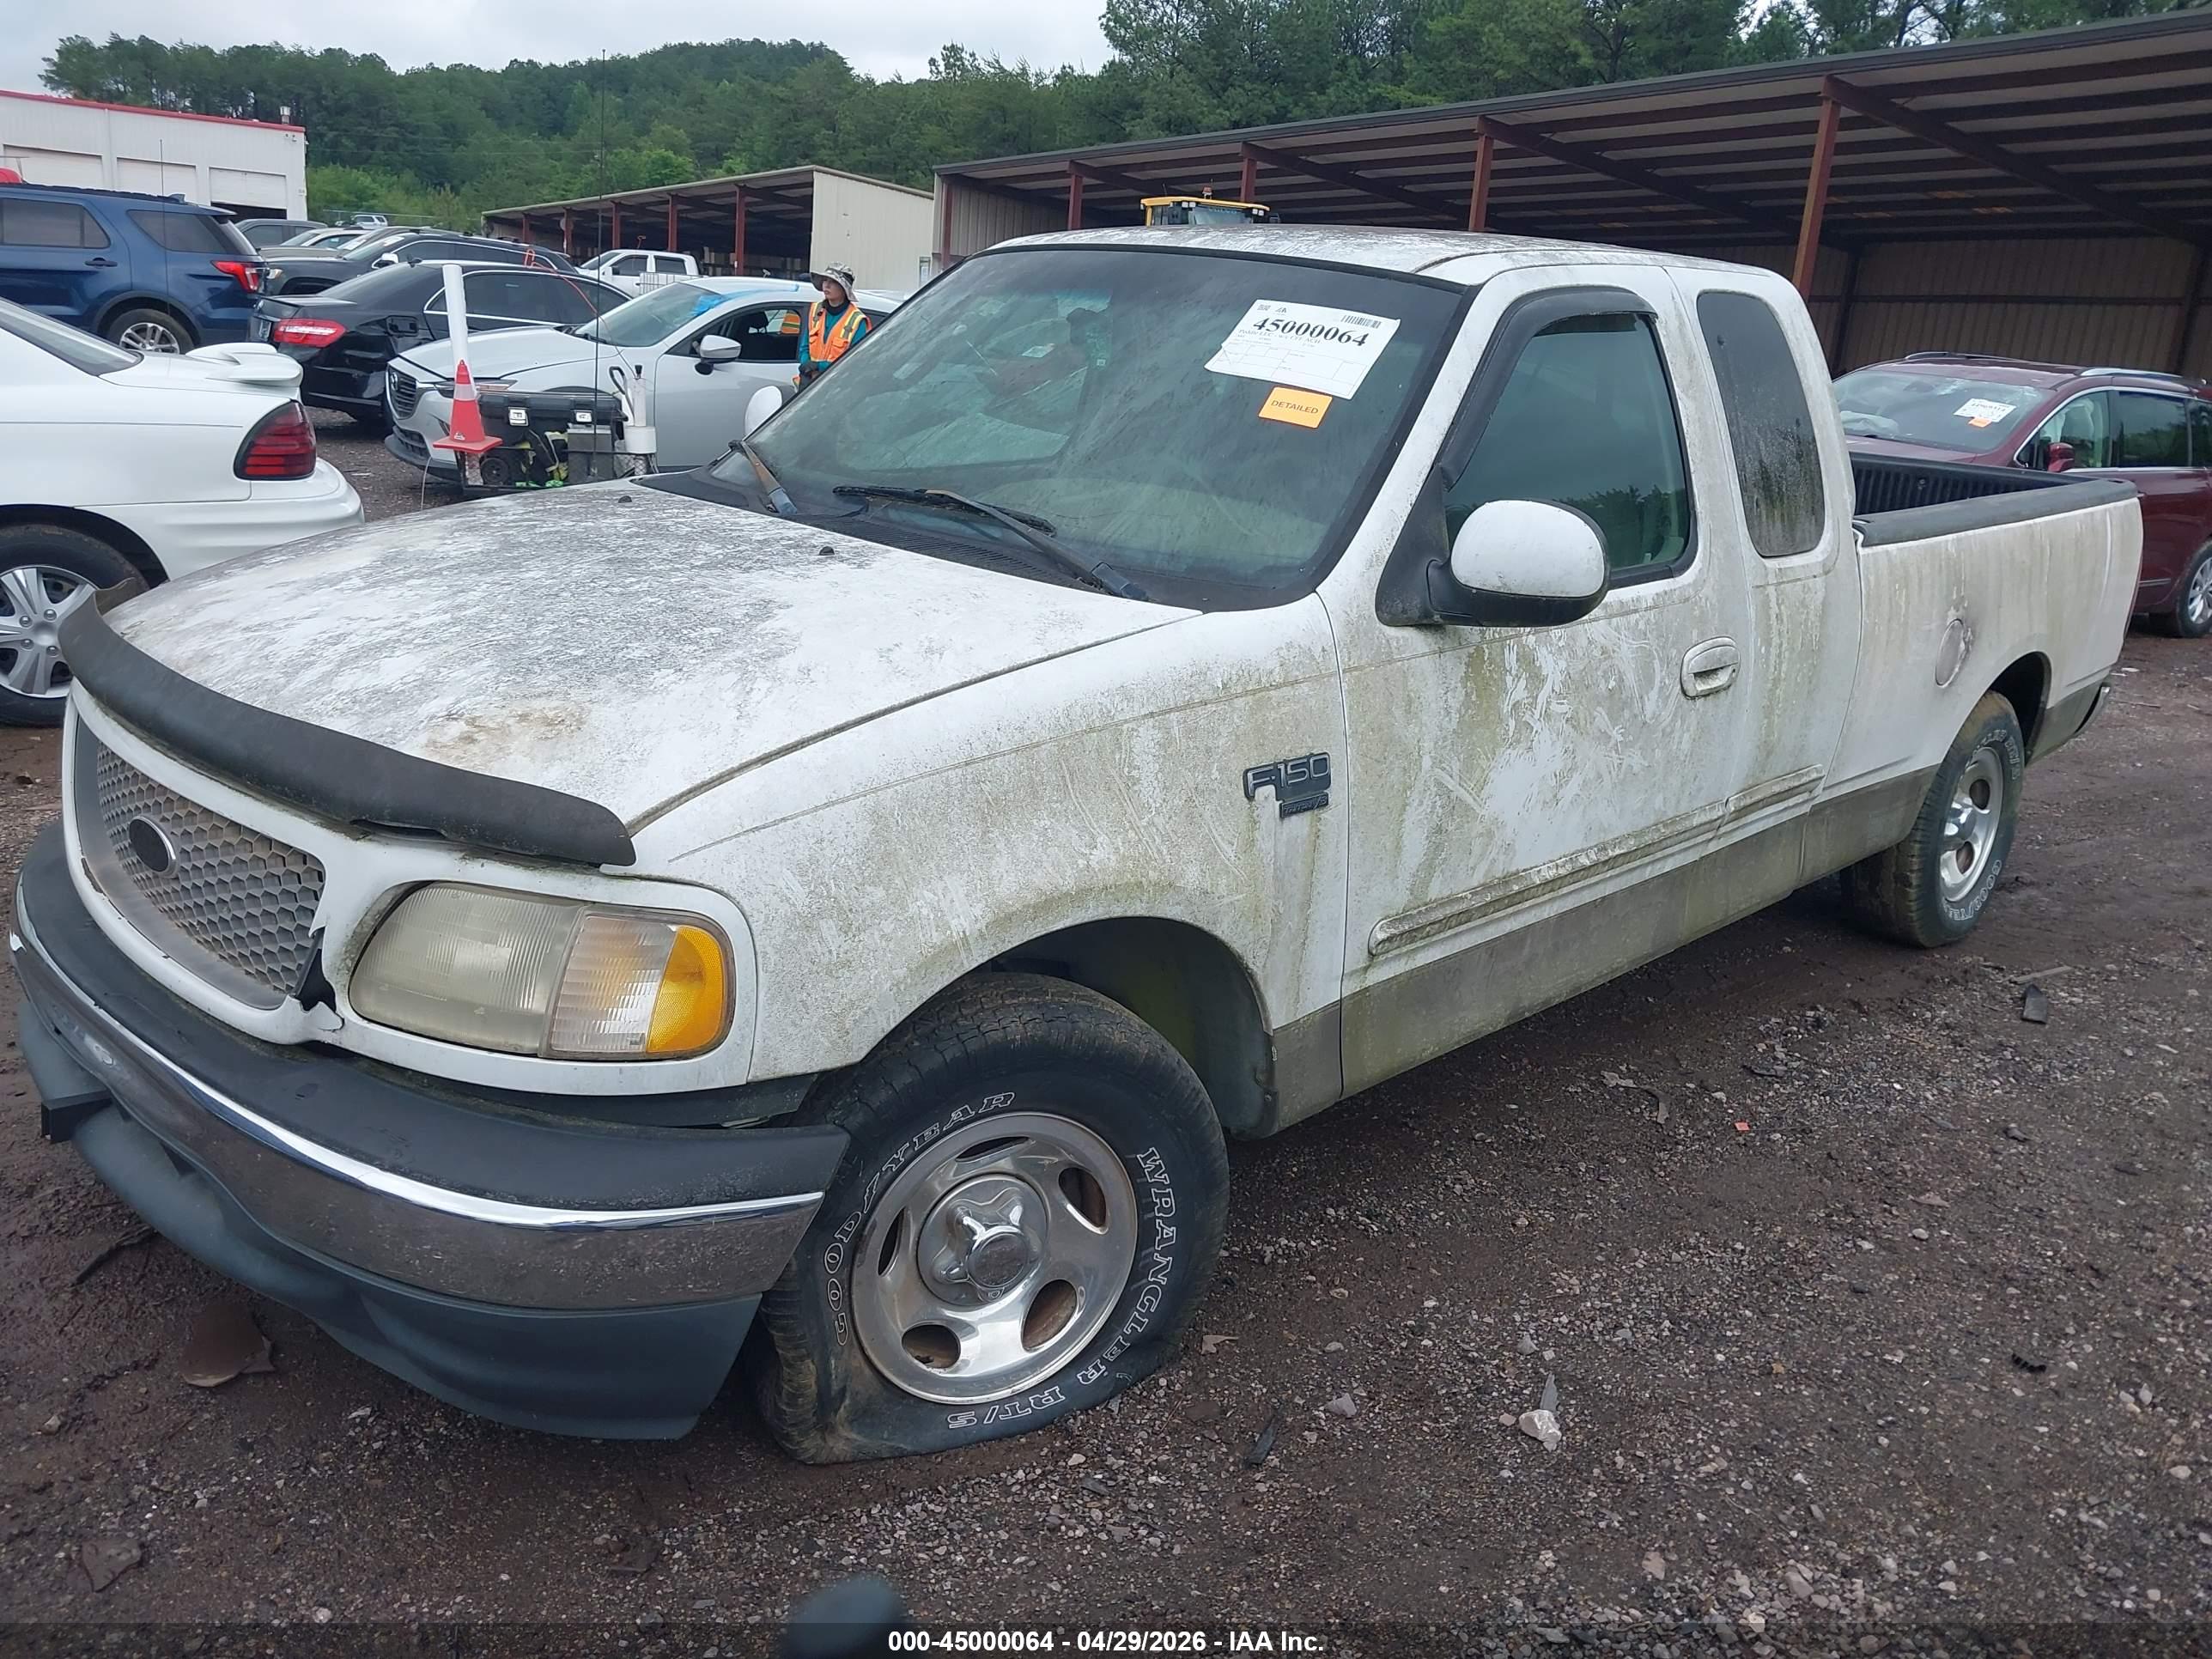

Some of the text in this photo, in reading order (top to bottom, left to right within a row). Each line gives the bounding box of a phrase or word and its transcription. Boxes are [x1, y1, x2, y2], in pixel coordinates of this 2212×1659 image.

[1252, 317, 1370, 347] 45000064
[1270, 399, 1319, 415] DETAILED
[823, 1091, 1017, 1347] GOODYEAR
[1076, 1146, 1179, 1387] WRANGLER
[946, 1385, 1066, 1431] RT/S
